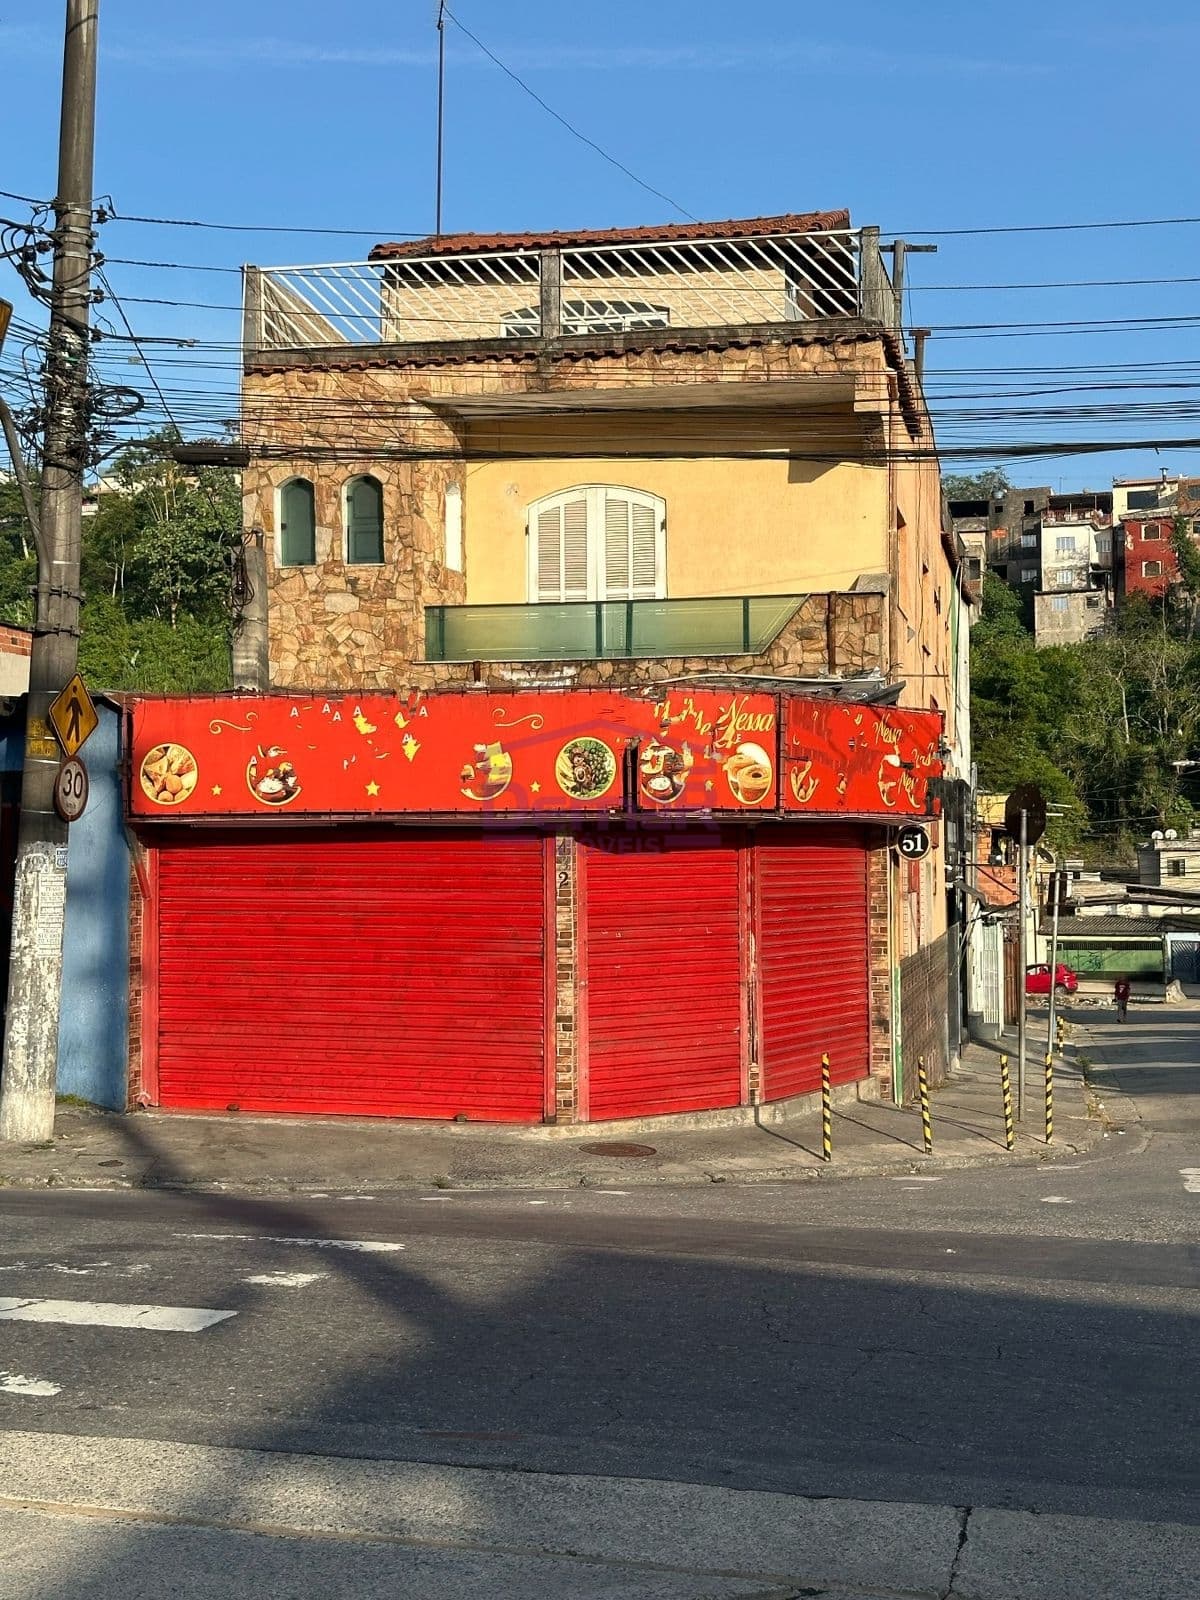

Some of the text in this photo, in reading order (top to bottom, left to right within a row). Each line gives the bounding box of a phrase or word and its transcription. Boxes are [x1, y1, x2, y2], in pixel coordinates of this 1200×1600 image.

[717, 695, 775, 748] Nessa
[63, 768, 83, 799] 30
[902, 833, 924, 852] 51
